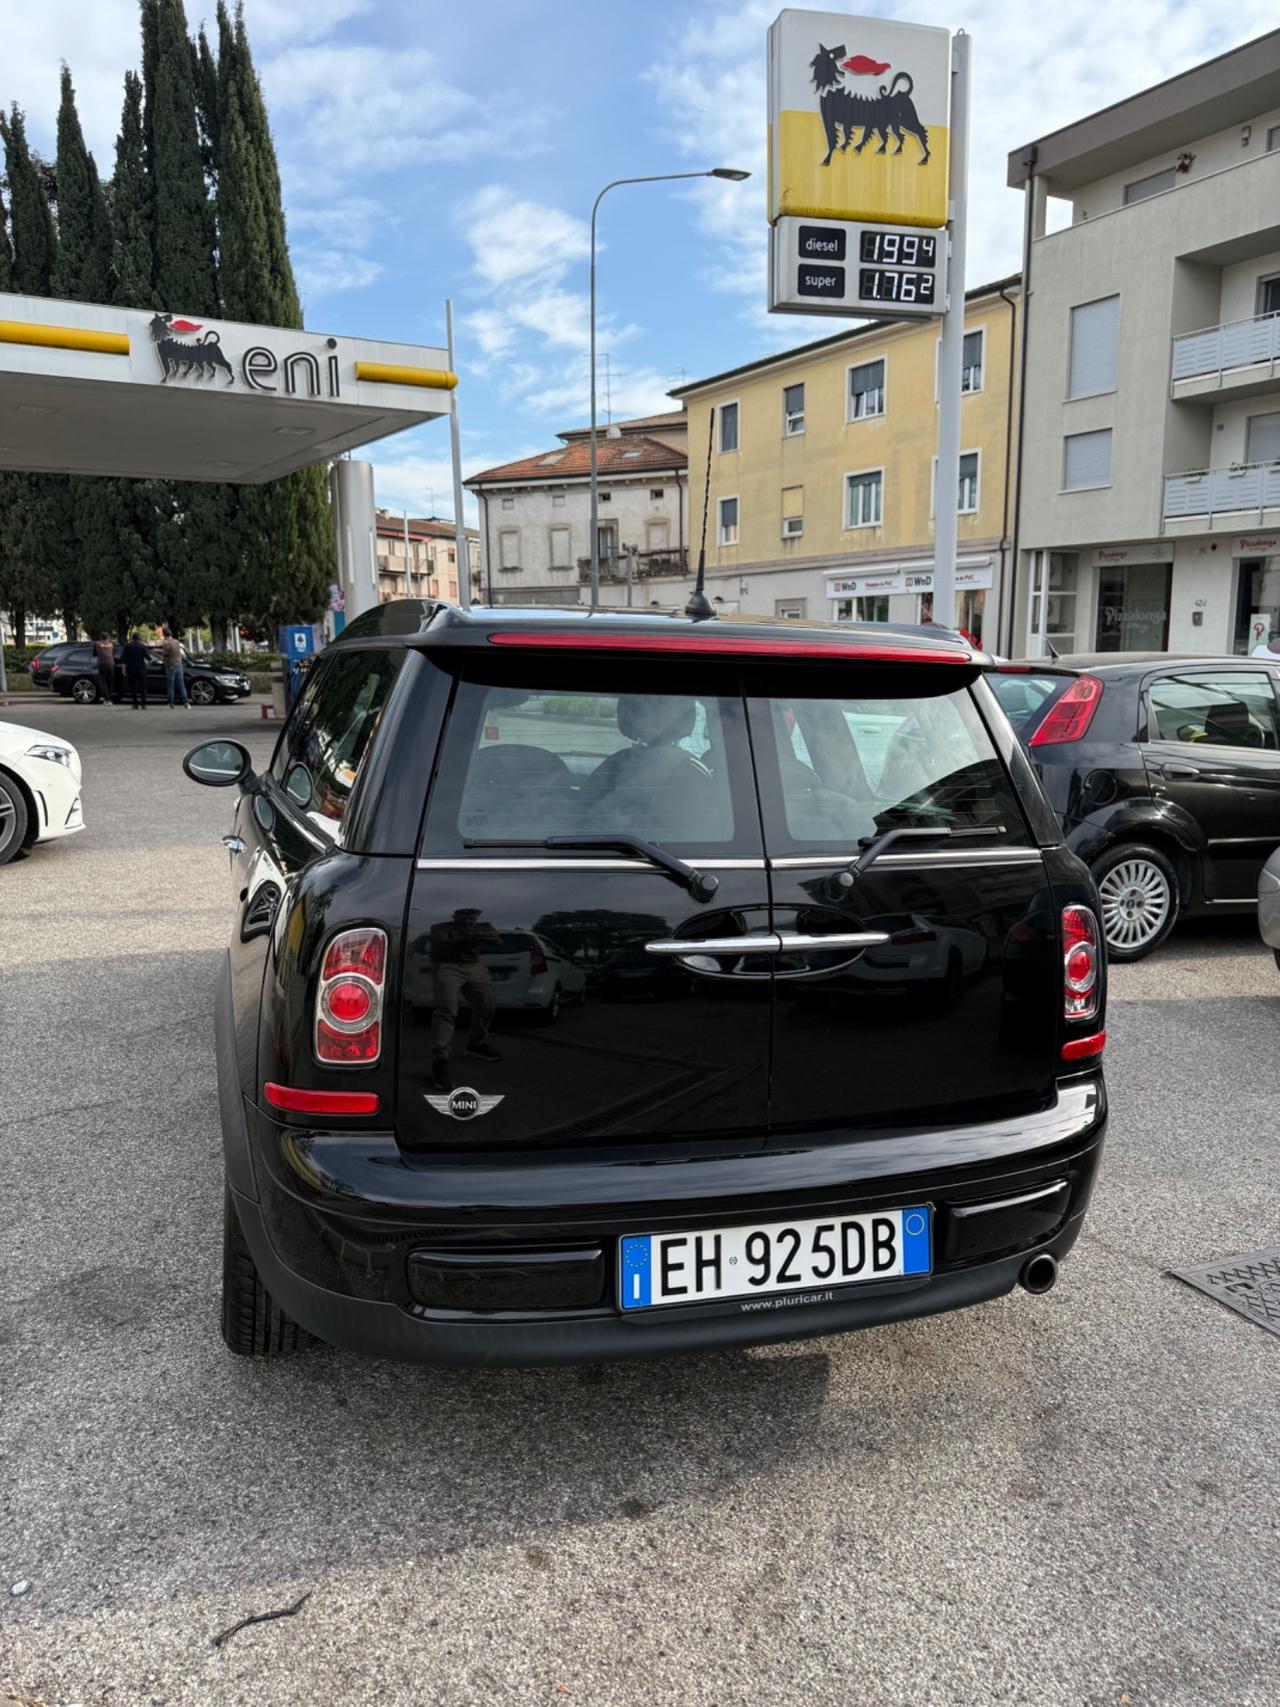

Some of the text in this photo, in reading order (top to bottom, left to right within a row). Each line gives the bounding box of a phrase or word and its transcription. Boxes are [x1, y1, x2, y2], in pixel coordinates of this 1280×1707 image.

[805, 238, 838, 252] diesel
[805, 275, 836, 288] super
[241, 337, 340, 398] eni
[1104, 606, 1167, 626] Pizzalonga
[452, 1100, 477, 1110] MINI
[660, 1217, 897, 1297] EH 925DB
[741, 1290, 833, 1312] www.pluricar.it
